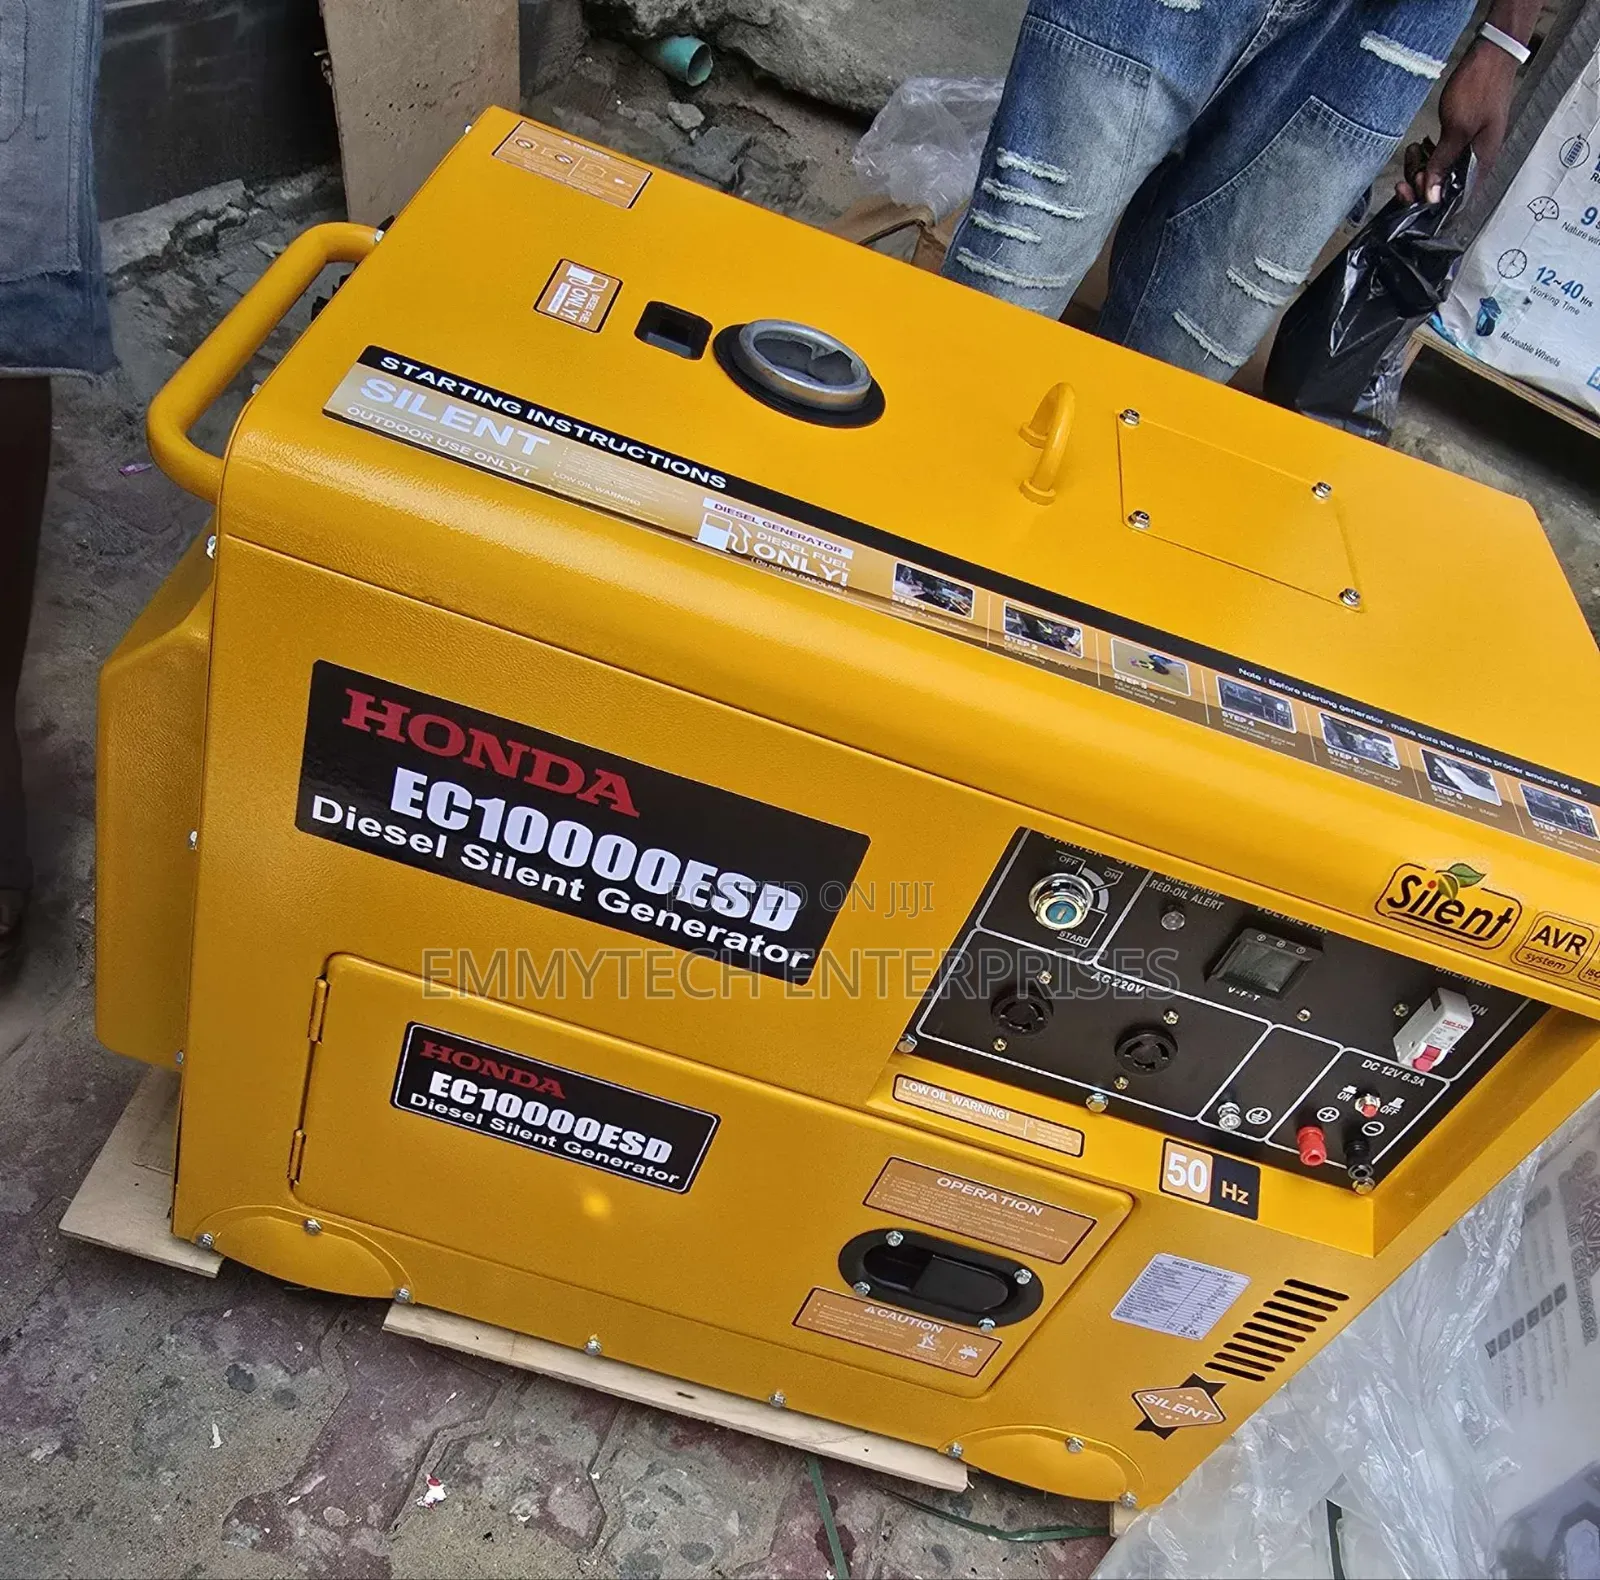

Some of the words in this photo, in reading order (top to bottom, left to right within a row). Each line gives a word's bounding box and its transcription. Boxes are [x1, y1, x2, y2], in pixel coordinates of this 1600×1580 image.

[1562, 222, 1588, 240] Nature
[1530, 284, 1560, 306] Working
[1561, 302, 1580, 316] Time
[1500, 331, 1536, 354] Moveable
[1535, 349, 1560, 368] Wheels
[347, 406, 434, 444] OUTDOOR
[436, 436, 472, 456] USE
[360, 377, 550, 456] SILENT
[380, 355, 522, 415] STARTING
[526, 408, 727, 489] INSTRUCTIONS
[714, 502, 760, 525] DIESEL
[762, 520, 842, 554] GENERATOR
[753, 542, 850, 587] ONLY!
[756, 531, 809, 558] DIESEL
[812, 551, 851, 571] FUEL
[1004, 634, 1031, 649] STEP
[1114, 672, 1140, 686] STEP
[1222, 710, 1247, 725] STEP
[1238, 666, 1262, 681] Note
[1268, 678, 1300, 696] Before
[1302, 690, 1338, 709] starting
[1338, 704, 1384, 724] generator
[1390, 722, 1417, 737] make
[1417, 733, 1438, 744] sure
[1440, 740, 1455, 752] the
[1456, 746, 1474, 758] unit
[1474, 751, 1492, 764] has
[1493, 759, 1524, 775] proper
[1525, 769, 1559, 786] amount
[342, 688, 640, 818] HONDA
[1327, 748, 1353, 762] STEP
[1430, 785, 1456, 798] STEP
[1532, 820, 1556, 834] STEP
[391, 766, 802, 932] EC10000ESD
[1058, 854, 1078, 868] OFF
[312, 794, 448, 860] Diesel
[460, 841, 586, 902] Silent
[597, 886, 810, 970] Generator
[1103, 868, 1118, 881] ON
[1150, 880, 1188, 901] RED-OIL
[1190, 892, 1226, 912] ALERT
[1386, 875, 1515, 940] Silent
[1058, 931, 1090, 946] START
[1531, 925, 1588, 956] AVR
[1524, 952, 1567, 970] system
[1090, 972, 1111, 986] AC
[1112, 978, 1146, 994] 220V
[1470, 1004, 1488, 1016] ON
[420, 1040, 567, 1100] HONDA
[1362, 1058, 1380, 1072] DC
[1381, 1063, 1401, 1080] 12V
[1400, 1070, 1426, 1088] 8.3A
[902, 1080, 930, 1095] LOW
[930, 1088, 950, 1103] OIL
[951, 1095, 1011, 1122] WARNING!
[1337, 1091, 1352, 1102] ON
[1380, 1104, 1401, 1116] OFF
[428, 1071, 672, 1164] EC10000ESD
[409, 1092, 484, 1125] Diesel
[489, 1116, 557, 1148] Silent
[563, 1140, 680, 1185] Generator
[1167, 1152, 1208, 1194] 50
[1221, 1180, 1250, 1205] Hz
[936, 1176, 1044, 1217] OPERATION
[876, 1310, 944, 1334] CAUTION
[1142, 1394, 1218, 1422] SILENT
